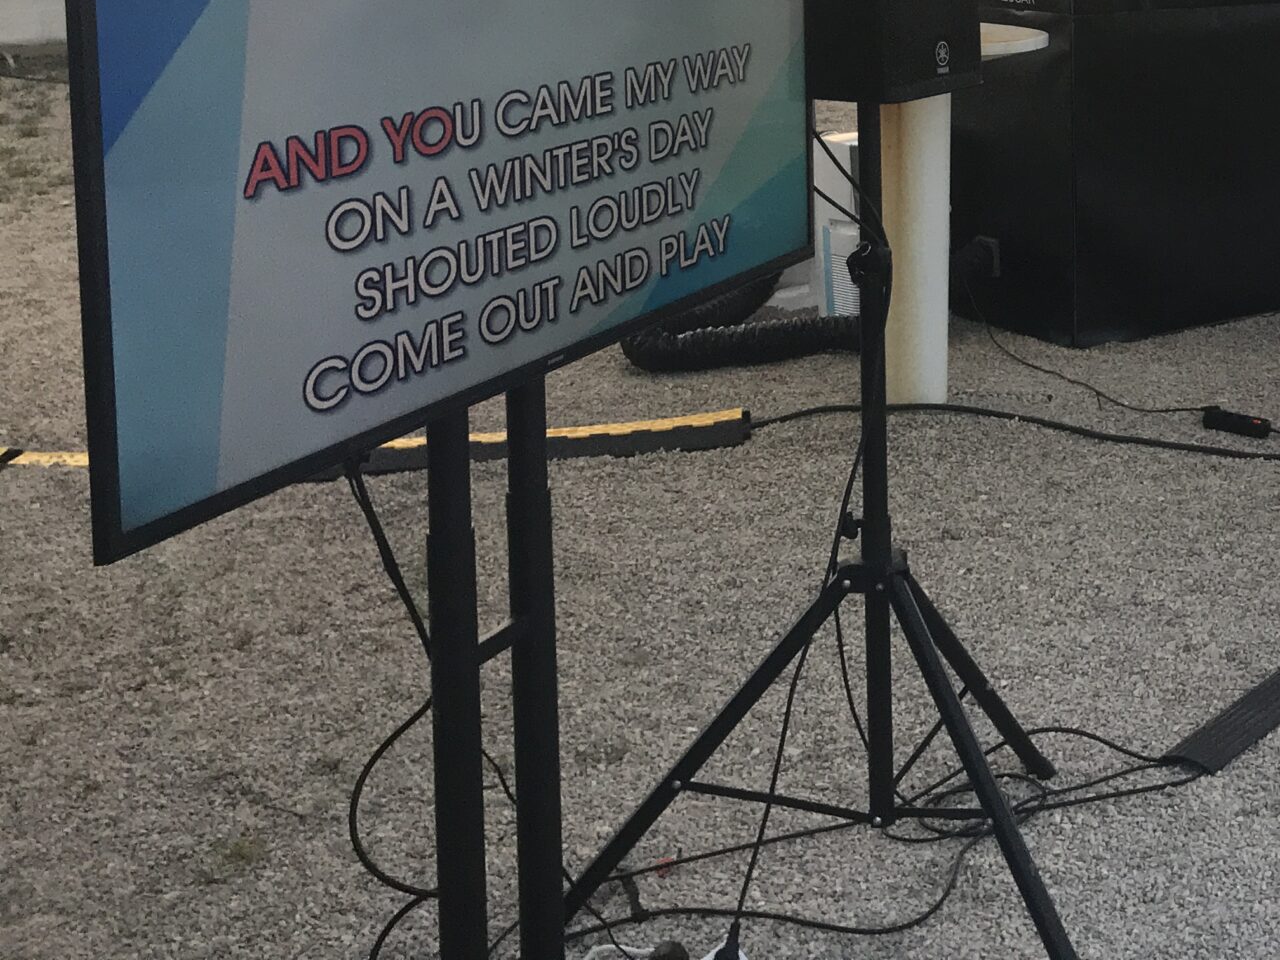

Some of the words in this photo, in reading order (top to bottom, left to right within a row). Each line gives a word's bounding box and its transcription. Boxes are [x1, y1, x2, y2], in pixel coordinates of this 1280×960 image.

[243, 124, 369, 199] AND
[380, 98, 481, 164] YOU
[494, 71, 614, 137] CAME
[624, 58, 677, 108] MY
[682, 43, 751, 93] WAY
[326, 185, 410, 252] ON
[424, 175, 461, 228] A
[468, 126, 640, 212] WINTER'S
[648, 107, 713, 163] DAY
[303, 310, 466, 413] COME
[478, 275, 561, 346] OUT
[569, 246, 649, 313] AND
[659, 213, 731, 277] PLAY
[355, 215, 558, 320] SHOUTED
[569, 167, 700, 249] LOUDLY
